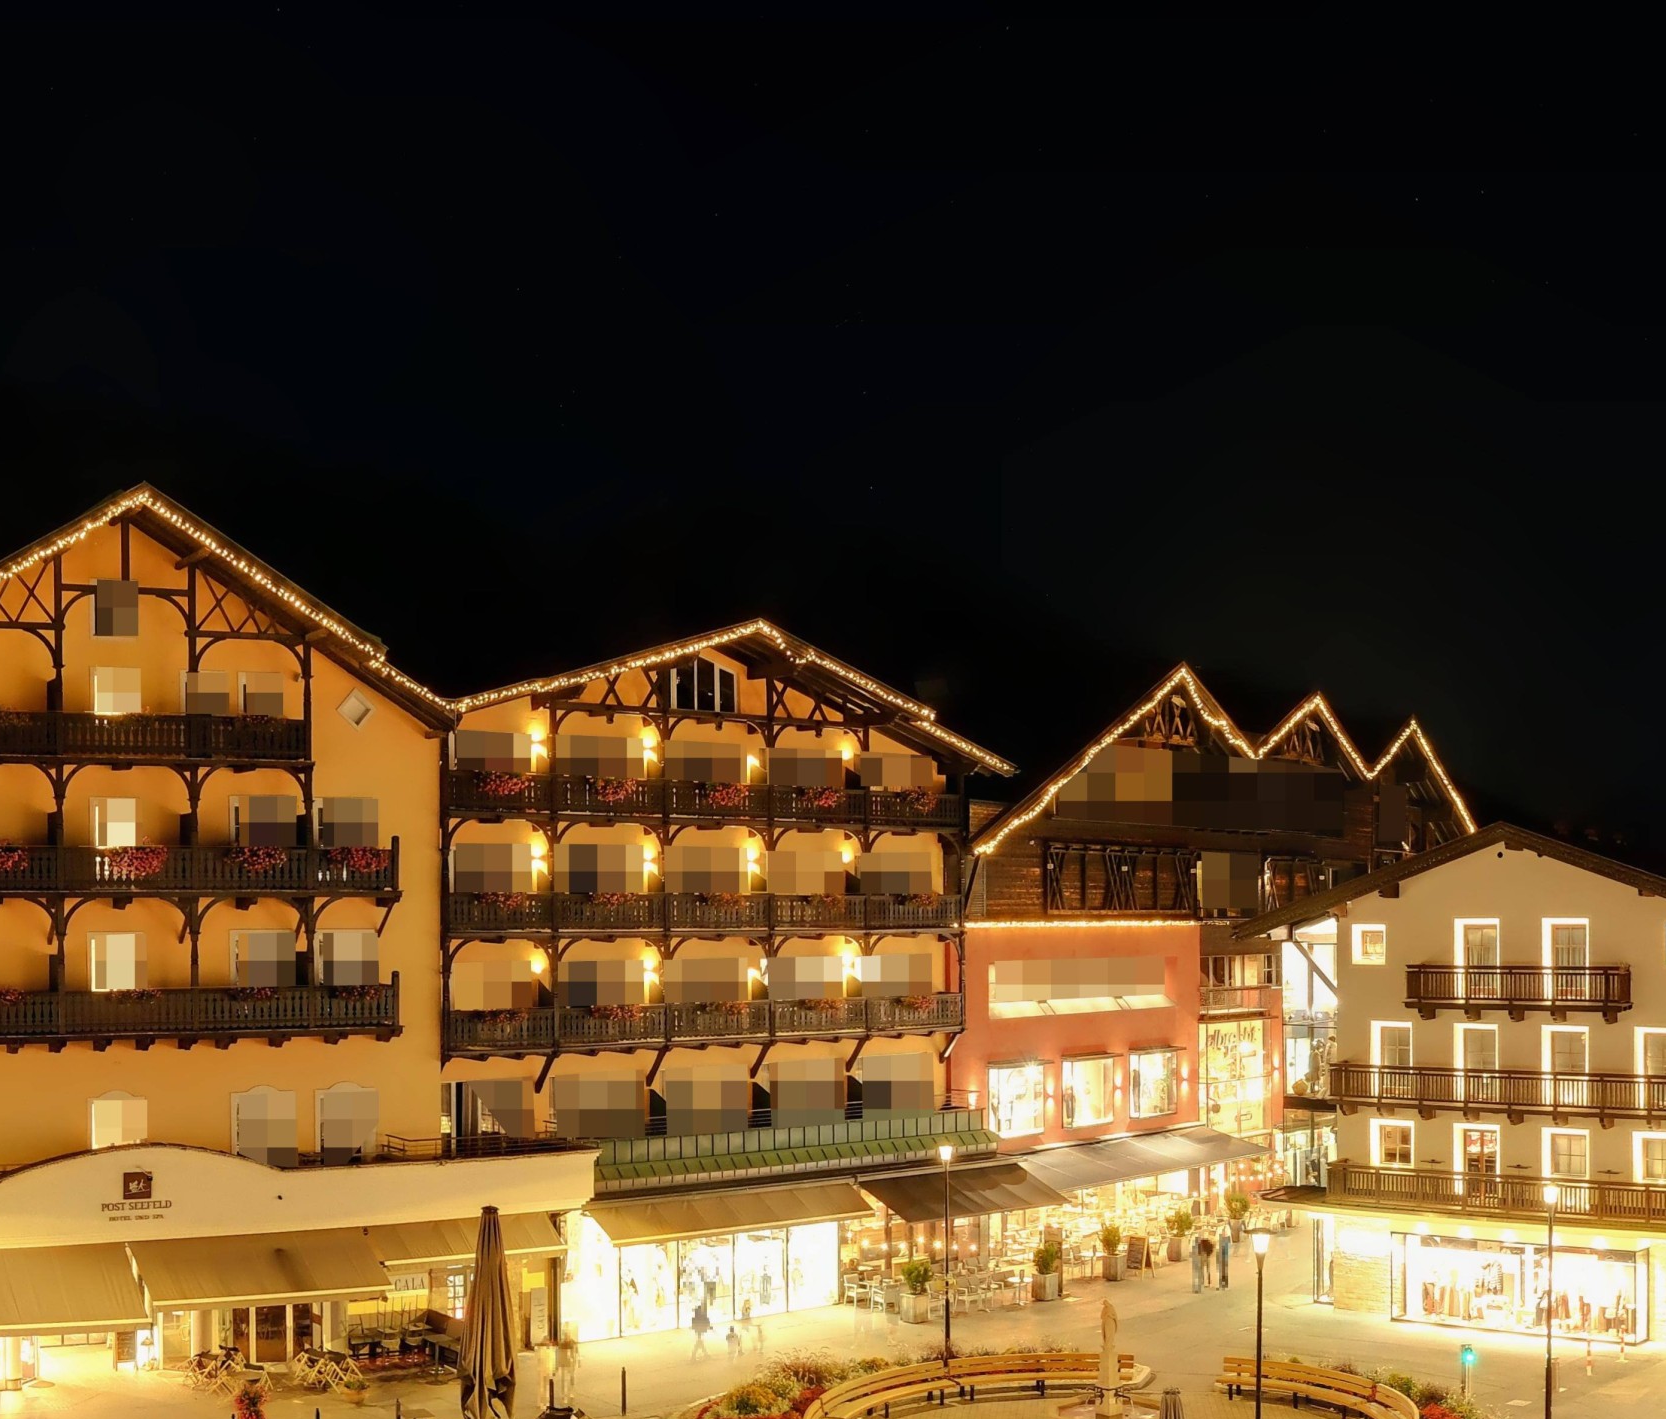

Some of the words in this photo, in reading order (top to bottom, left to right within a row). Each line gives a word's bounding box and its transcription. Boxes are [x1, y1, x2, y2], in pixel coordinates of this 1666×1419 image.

[101, 1202, 126, 1212] POST
[128, 1200, 172, 1210] SEEFELD
[394, 1276, 425, 1292] CALA
